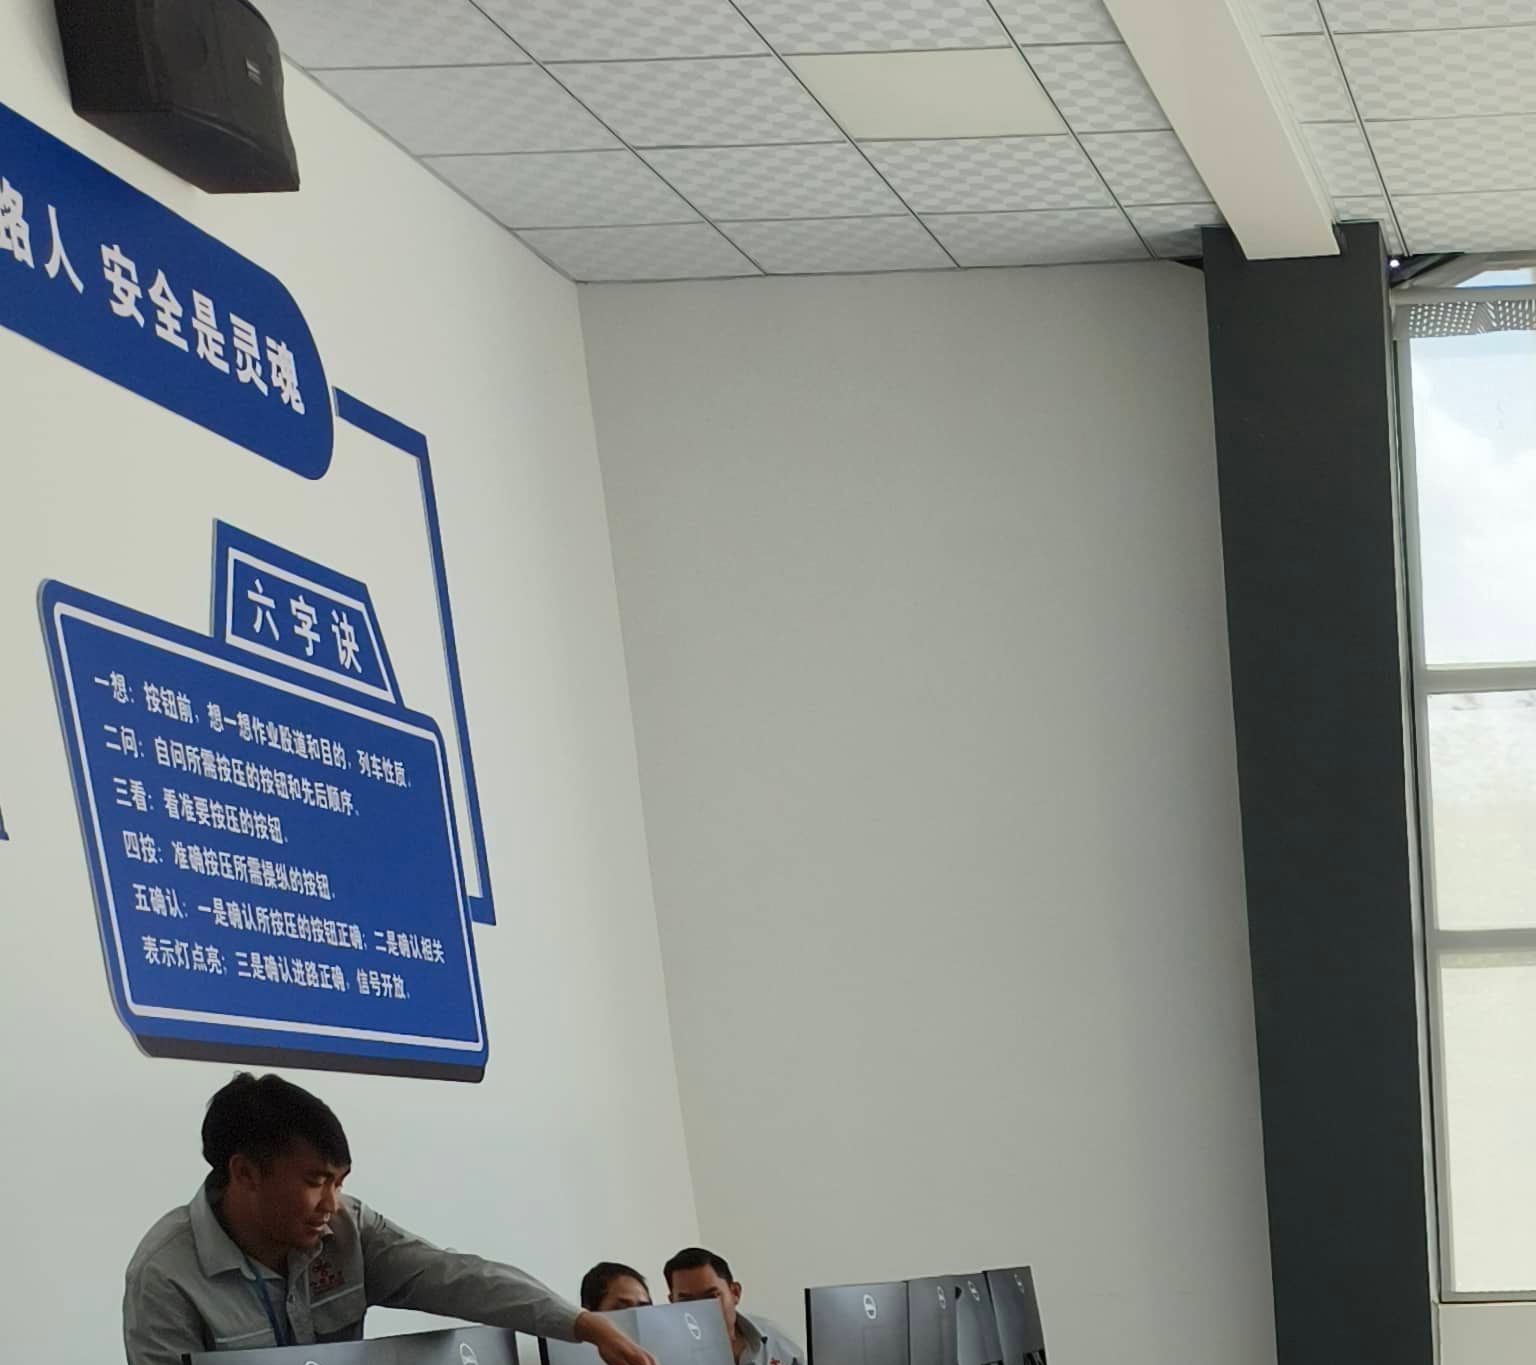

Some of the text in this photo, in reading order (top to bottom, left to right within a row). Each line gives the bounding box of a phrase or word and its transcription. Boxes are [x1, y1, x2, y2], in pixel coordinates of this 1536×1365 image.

[101, 244, 305, 414] 安全是灵魂
[248, 579, 362, 673] 六字诀
